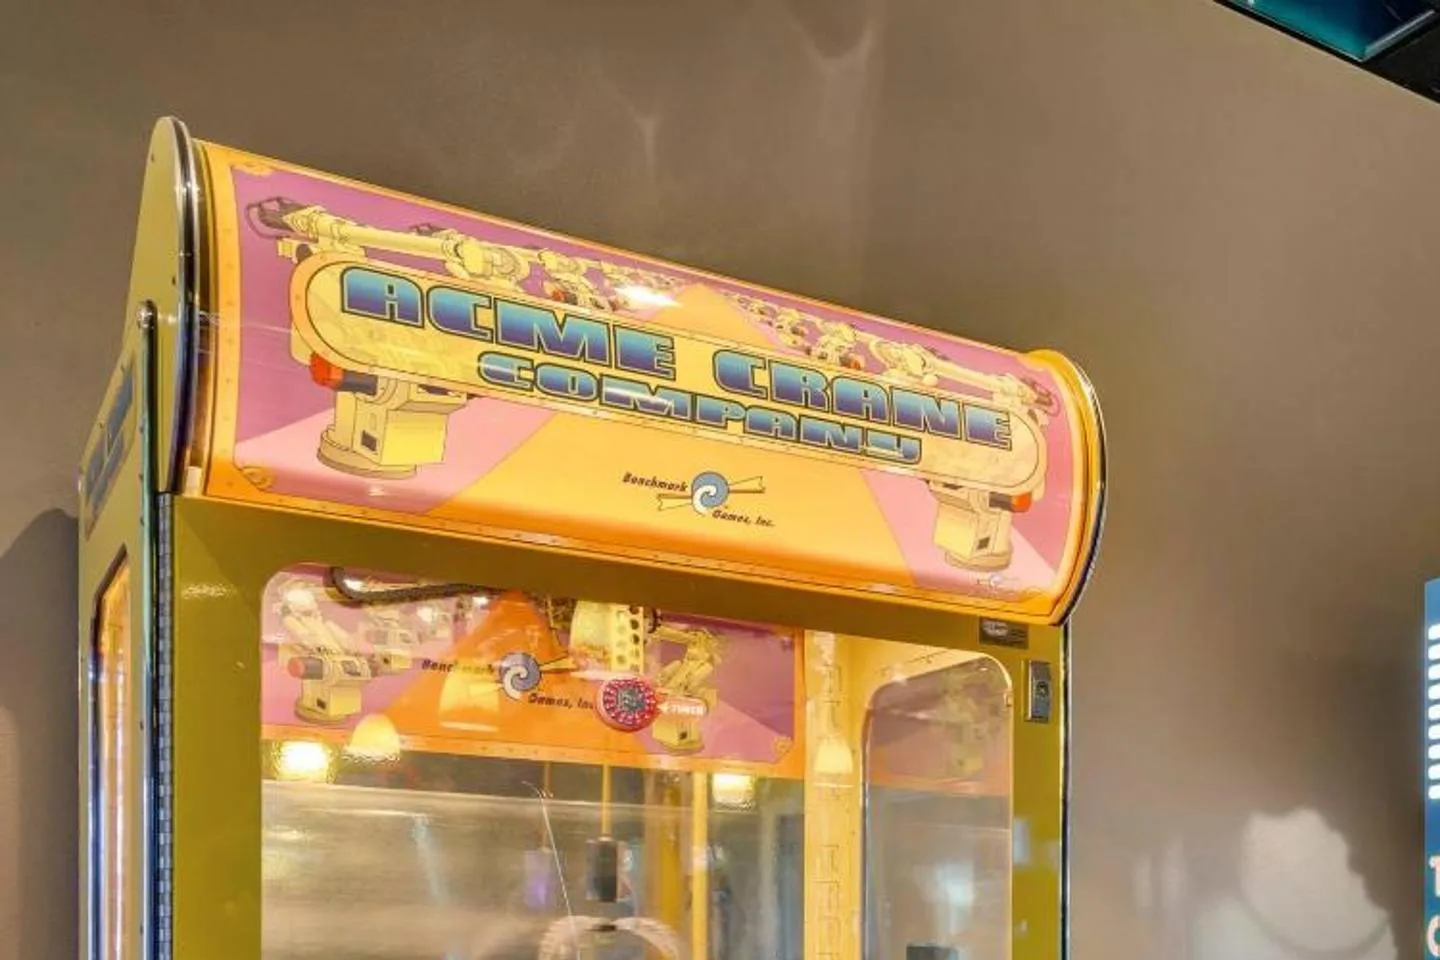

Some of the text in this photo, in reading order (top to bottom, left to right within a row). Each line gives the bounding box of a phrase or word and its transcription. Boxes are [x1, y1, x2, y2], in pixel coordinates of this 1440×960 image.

[340, 266, 1012, 451] ACME CRANE
[477, 351, 922, 465] COMPANY
[622, 471, 688, 492] Benchmark
[712, 509, 775, 527] Games, Inc.
[422, 659, 494, 674] Bencmark
